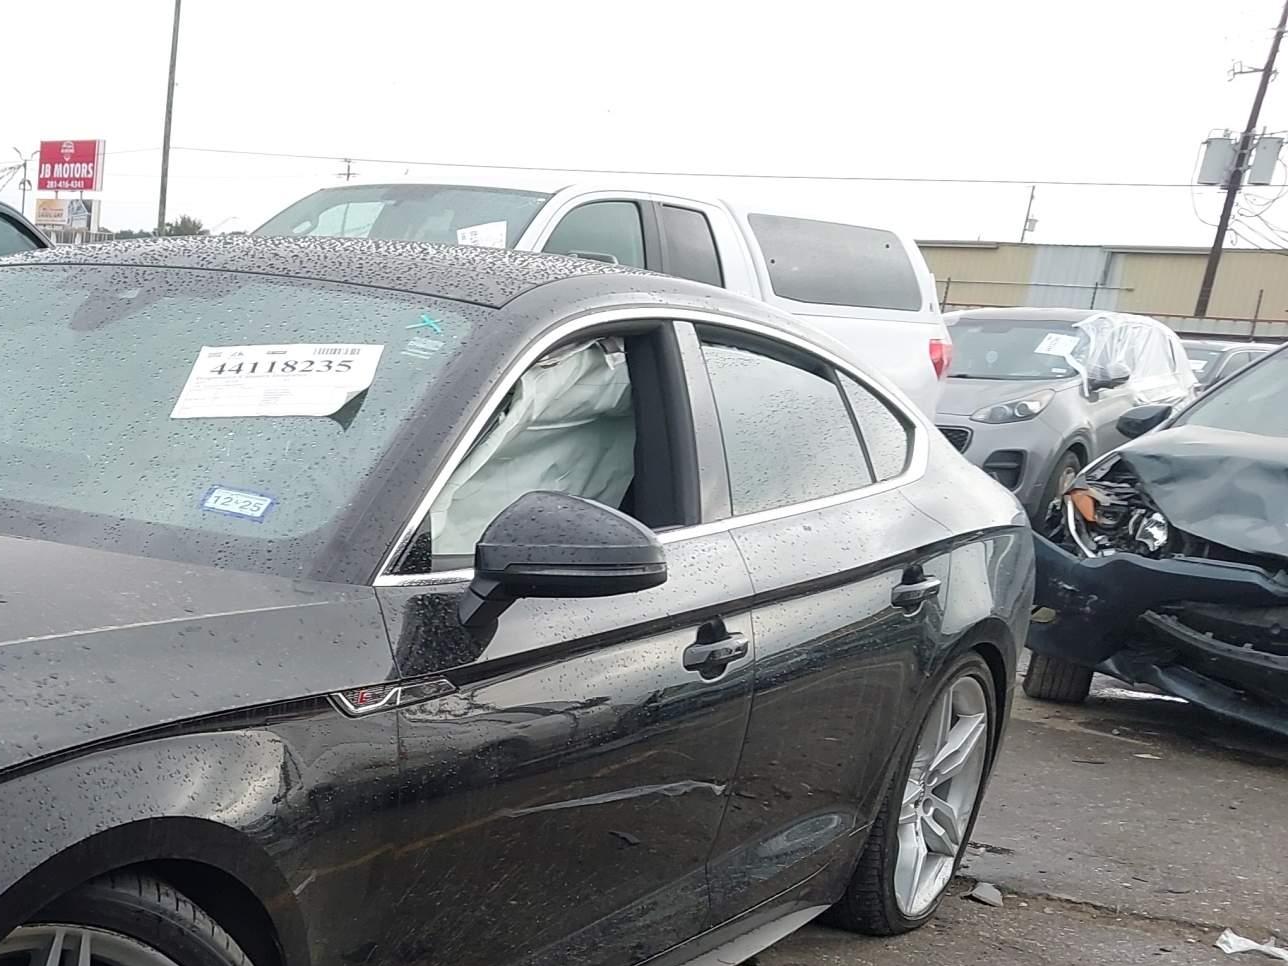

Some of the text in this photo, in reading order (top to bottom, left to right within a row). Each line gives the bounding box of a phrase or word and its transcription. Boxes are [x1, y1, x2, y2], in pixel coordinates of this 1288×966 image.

[40, 162, 93, 178] JB MOTORS
[208, 359, 355, 375] 44118235
[213, 495, 264, 512] 12 25
